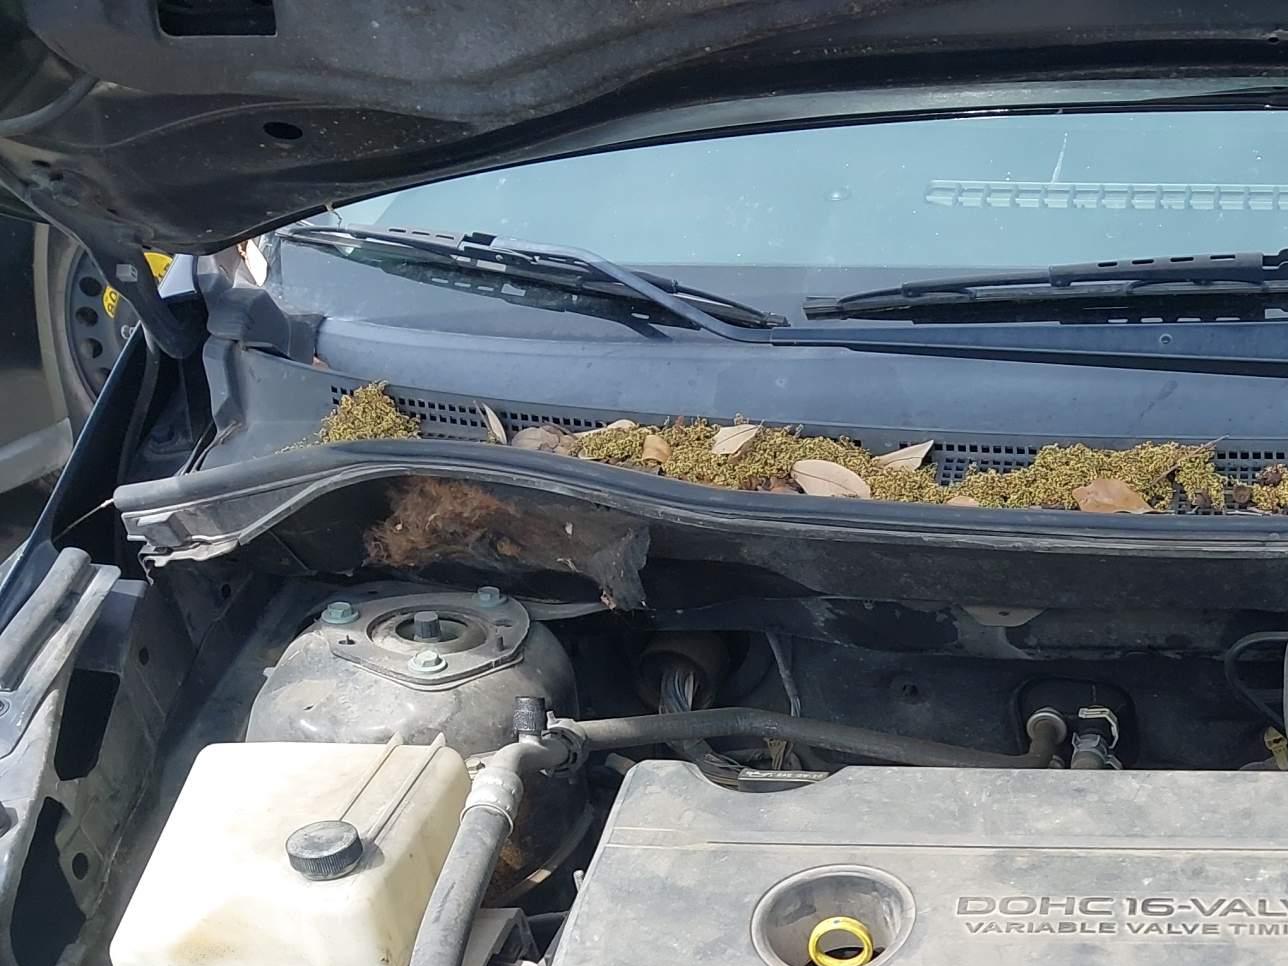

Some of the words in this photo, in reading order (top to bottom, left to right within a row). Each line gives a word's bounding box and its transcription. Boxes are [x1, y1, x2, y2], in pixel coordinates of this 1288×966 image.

[956, 895, 1114, 917] DOHC
[965, 920, 1117, 935] VARIABLE
[1126, 921, 1220, 936] VALVE
